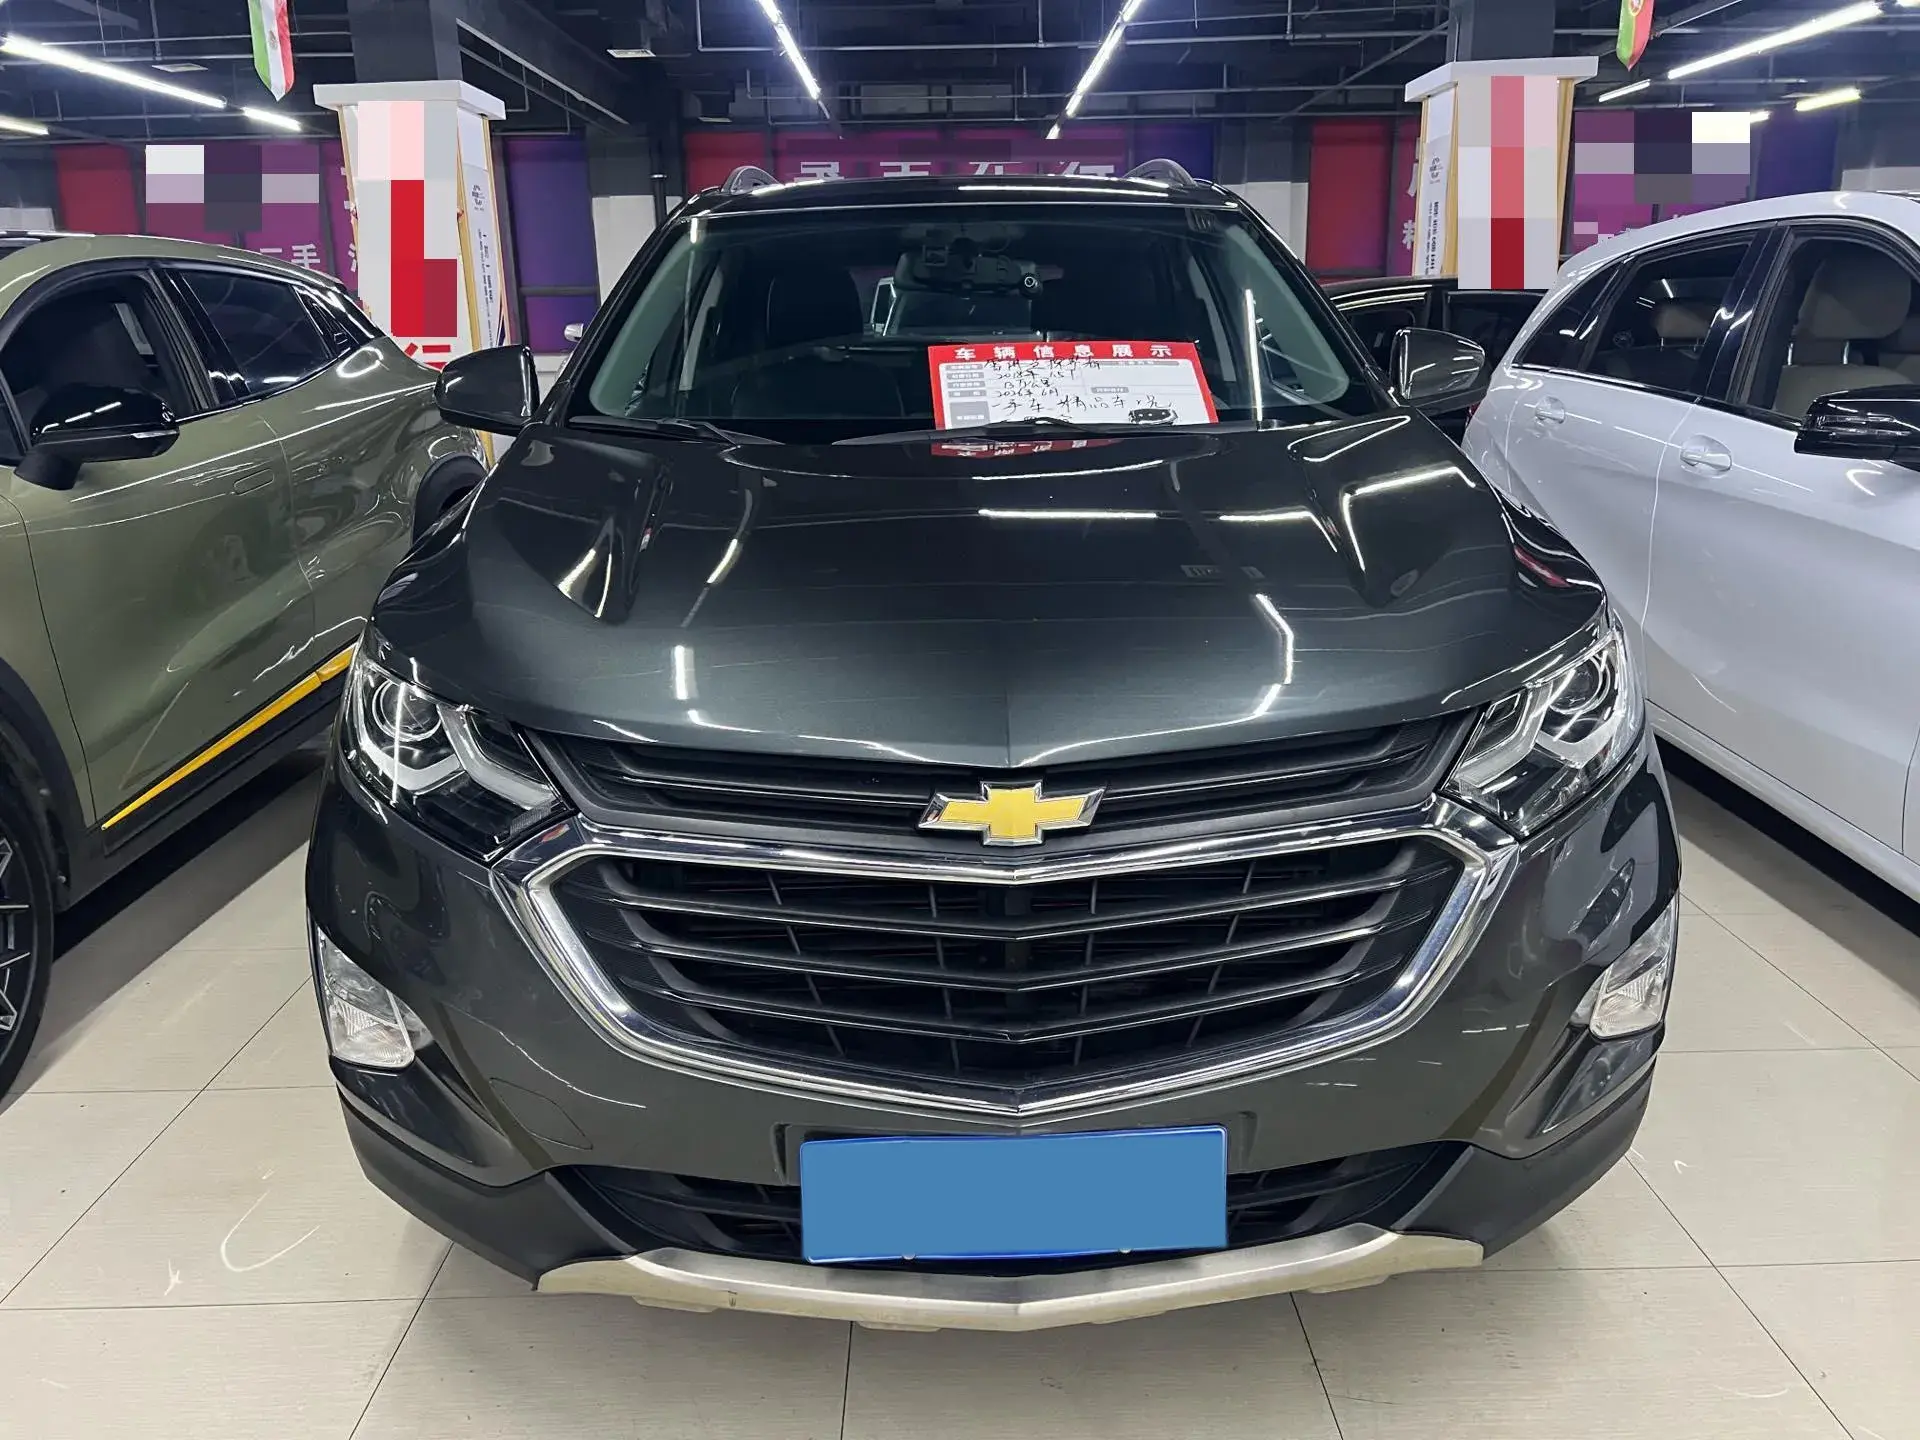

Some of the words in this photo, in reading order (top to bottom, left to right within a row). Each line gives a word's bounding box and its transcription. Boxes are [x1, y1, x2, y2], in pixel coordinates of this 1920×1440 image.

[954, 344, 1173, 360] 车辆信息展示
